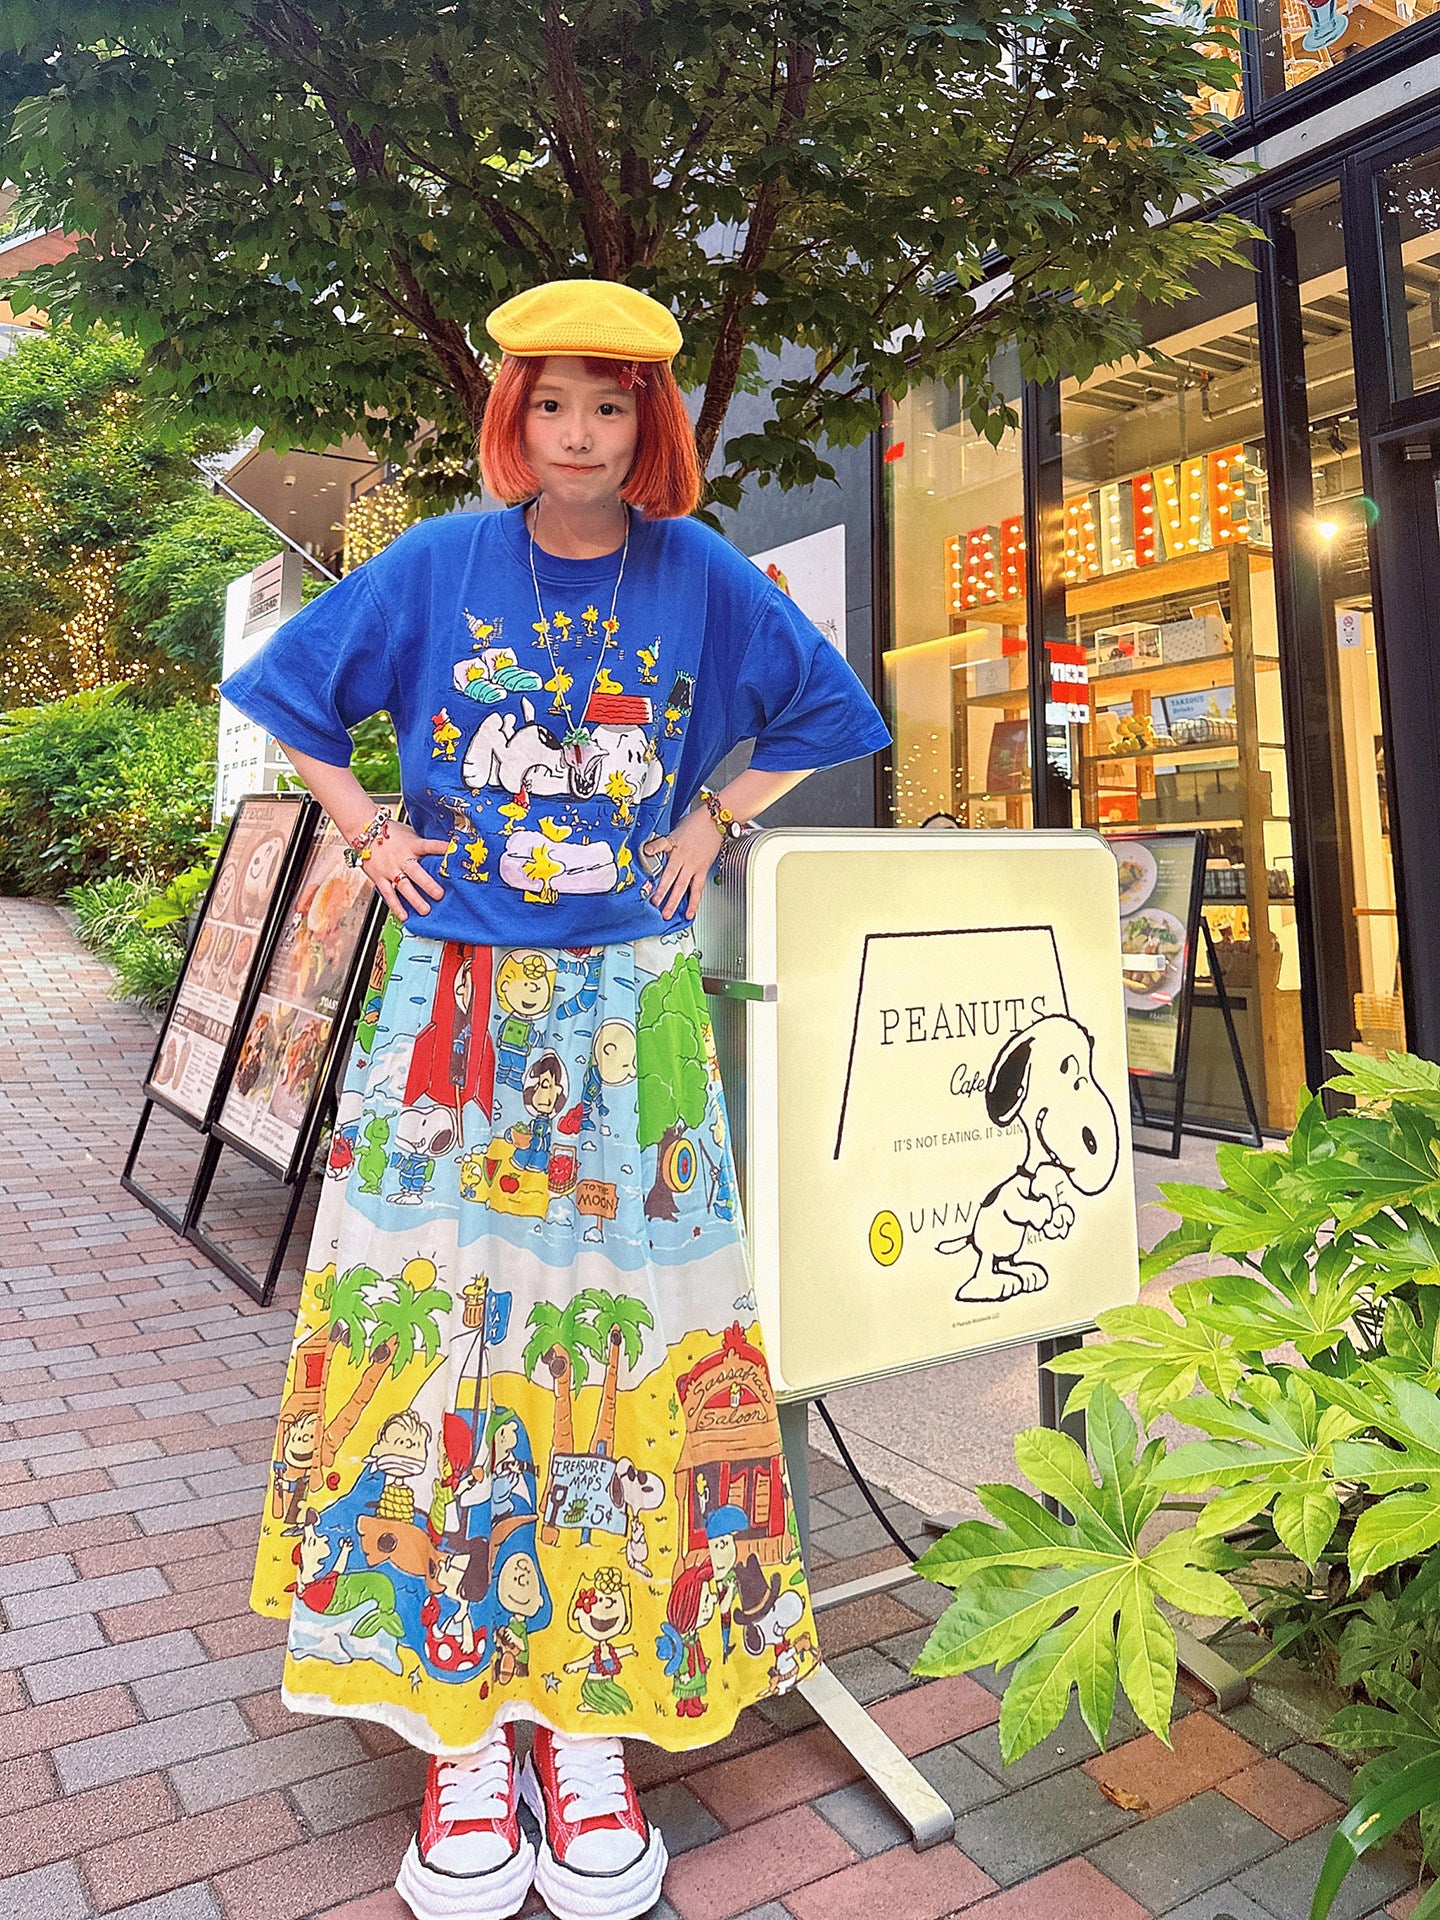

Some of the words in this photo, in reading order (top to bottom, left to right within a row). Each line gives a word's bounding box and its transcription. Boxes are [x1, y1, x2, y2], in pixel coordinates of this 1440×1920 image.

[1063, 443, 1250, 584] ALIVE
[879, 995, 1046, 1046] PEANUTS
[893, 1138, 913, 1153] IT'S
[915, 1134, 938, 1149] NOT
[583, 1183, 596, 1191] TO
[577, 1194, 614, 1211] MOON
[687, 1365, 771, 1419] Sassafras
[697, 1409, 767, 1430] Saloon
[554, 1459, 607, 1475] TREASURE
